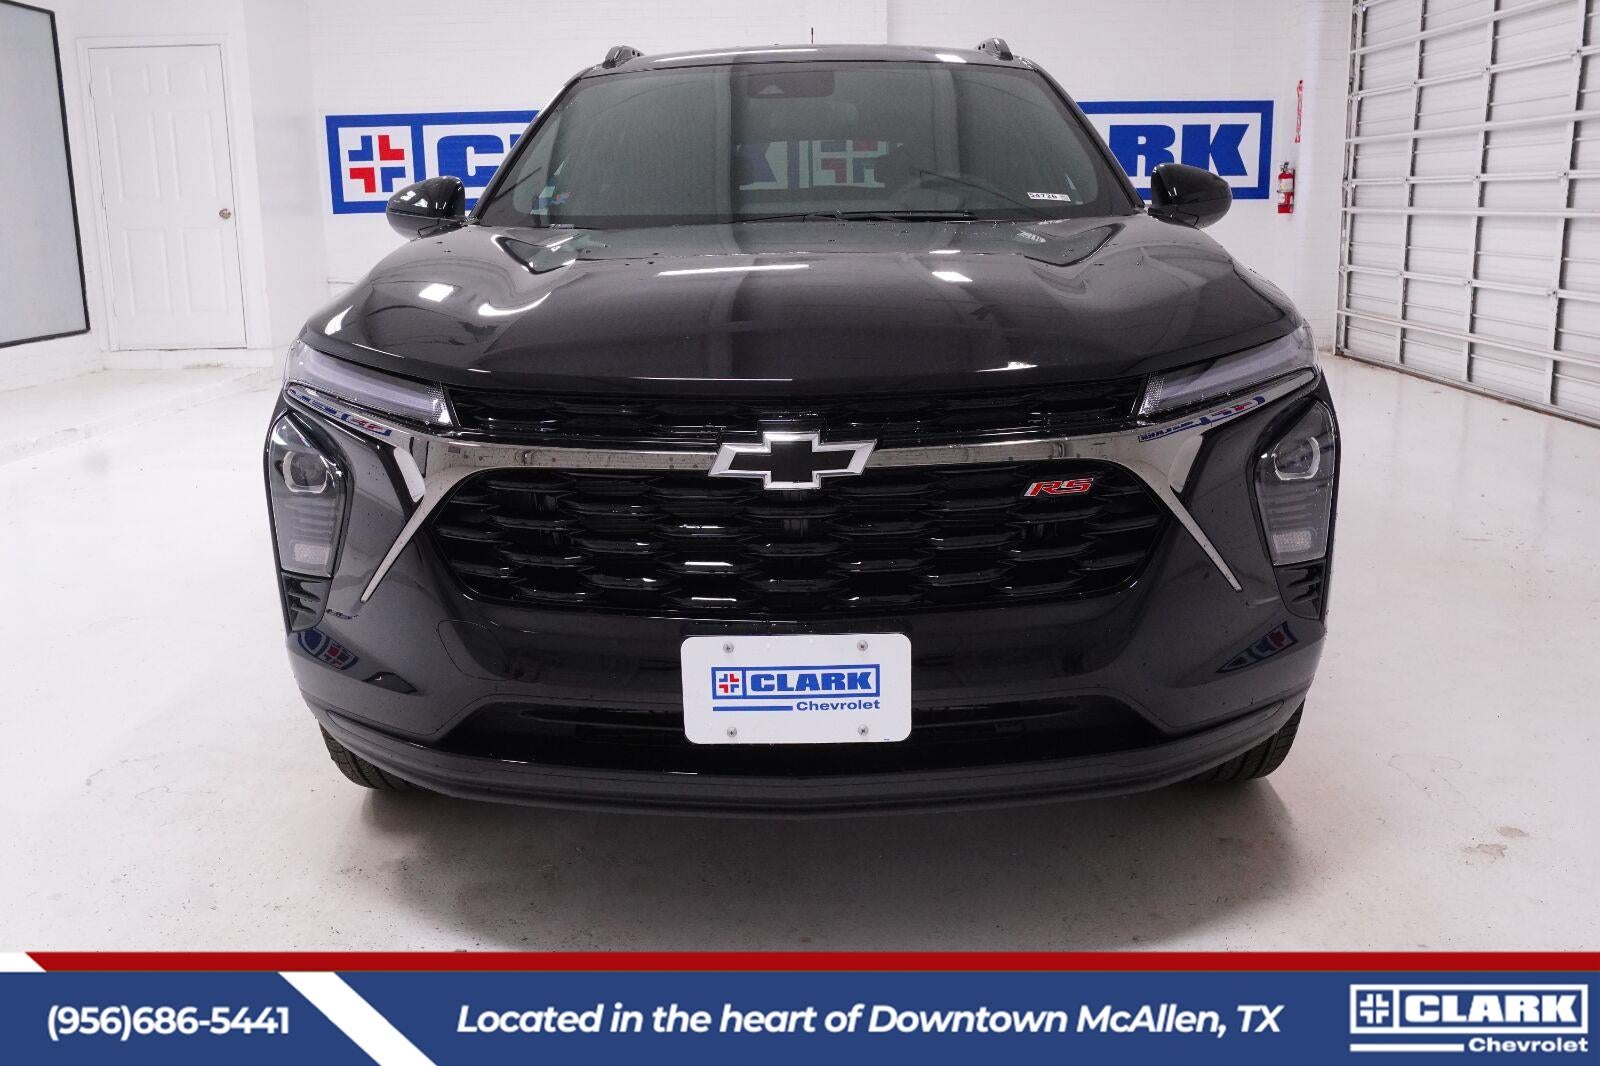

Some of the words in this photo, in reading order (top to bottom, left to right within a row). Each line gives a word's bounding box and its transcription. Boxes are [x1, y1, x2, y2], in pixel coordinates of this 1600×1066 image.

[1024, 478, 1094, 496] RS
[751, 671, 872, 692] CLARK
[796, 701, 881, 712] Chevrolet
